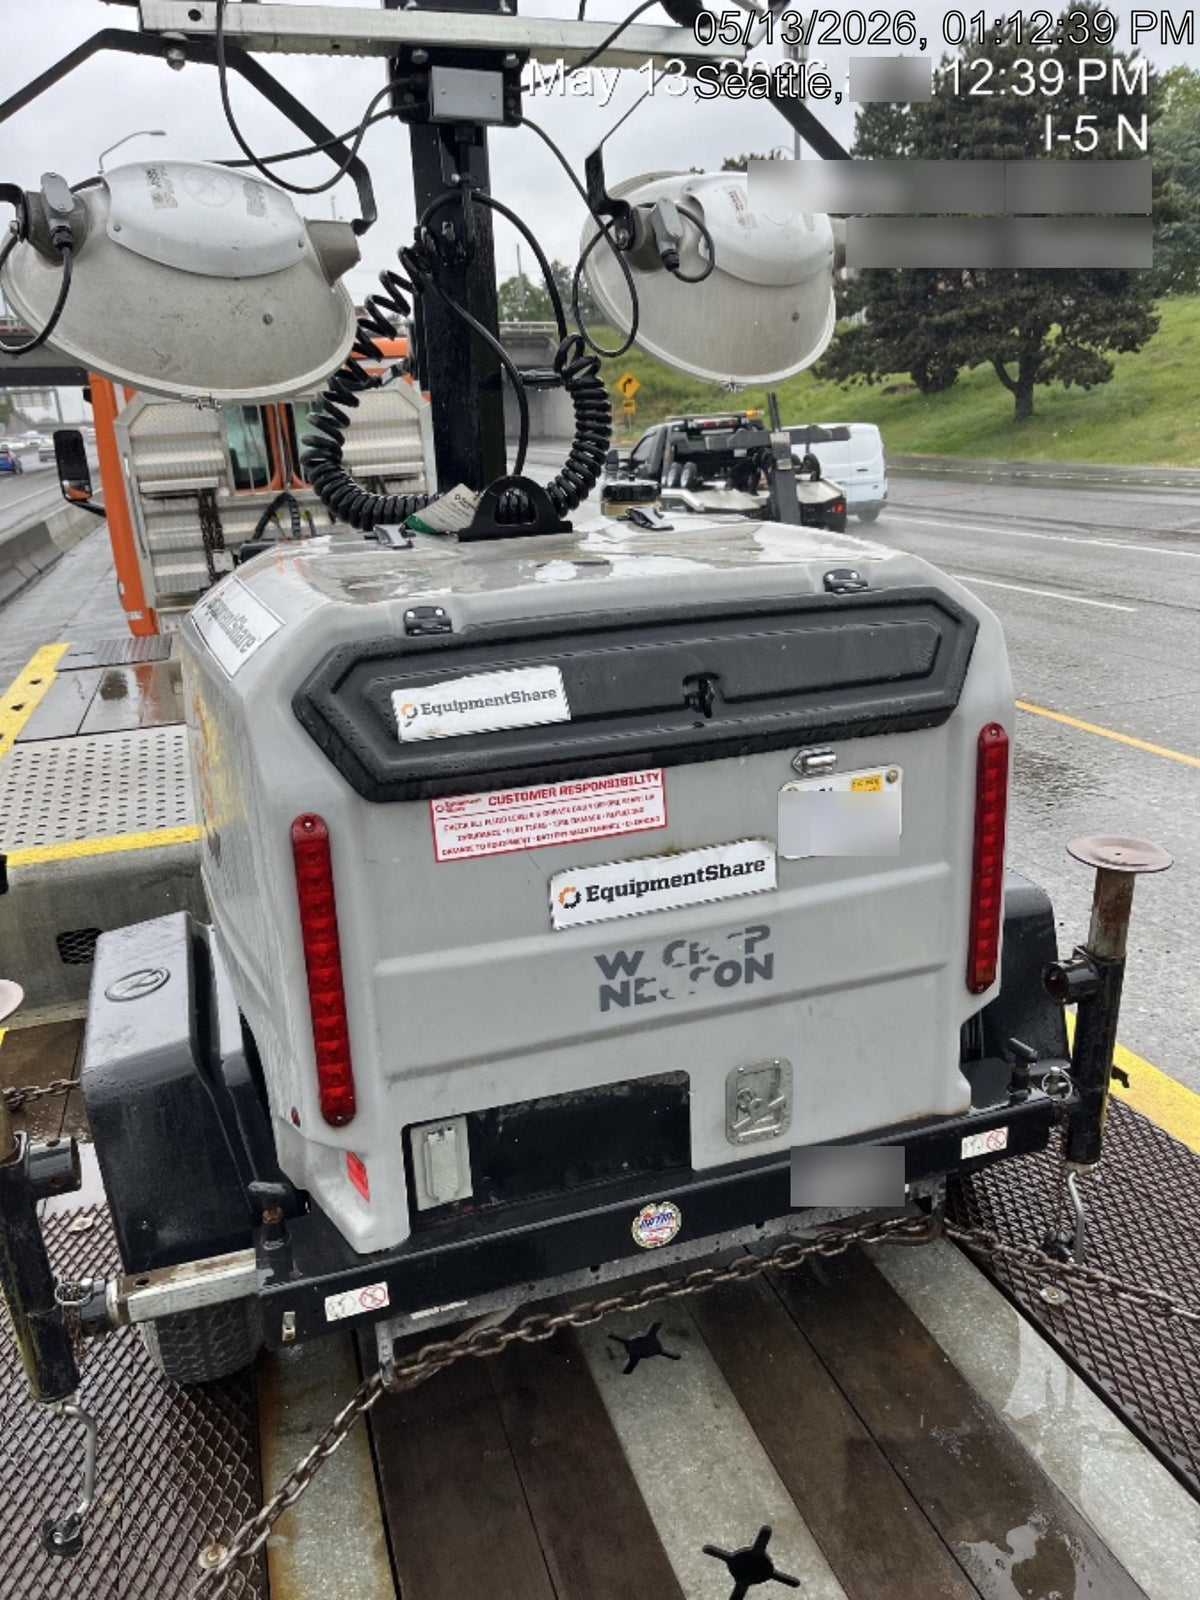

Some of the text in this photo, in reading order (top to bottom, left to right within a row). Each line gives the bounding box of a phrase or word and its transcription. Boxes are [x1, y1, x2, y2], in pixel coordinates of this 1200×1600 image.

[420, 687, 558, 716] EquipmentShare
[488, 787, 557, 806] CUSTOMER
[559, 772, 660, 796] RESPONSIBILITY
[585, 859, 766, 903] EquipmentShare
